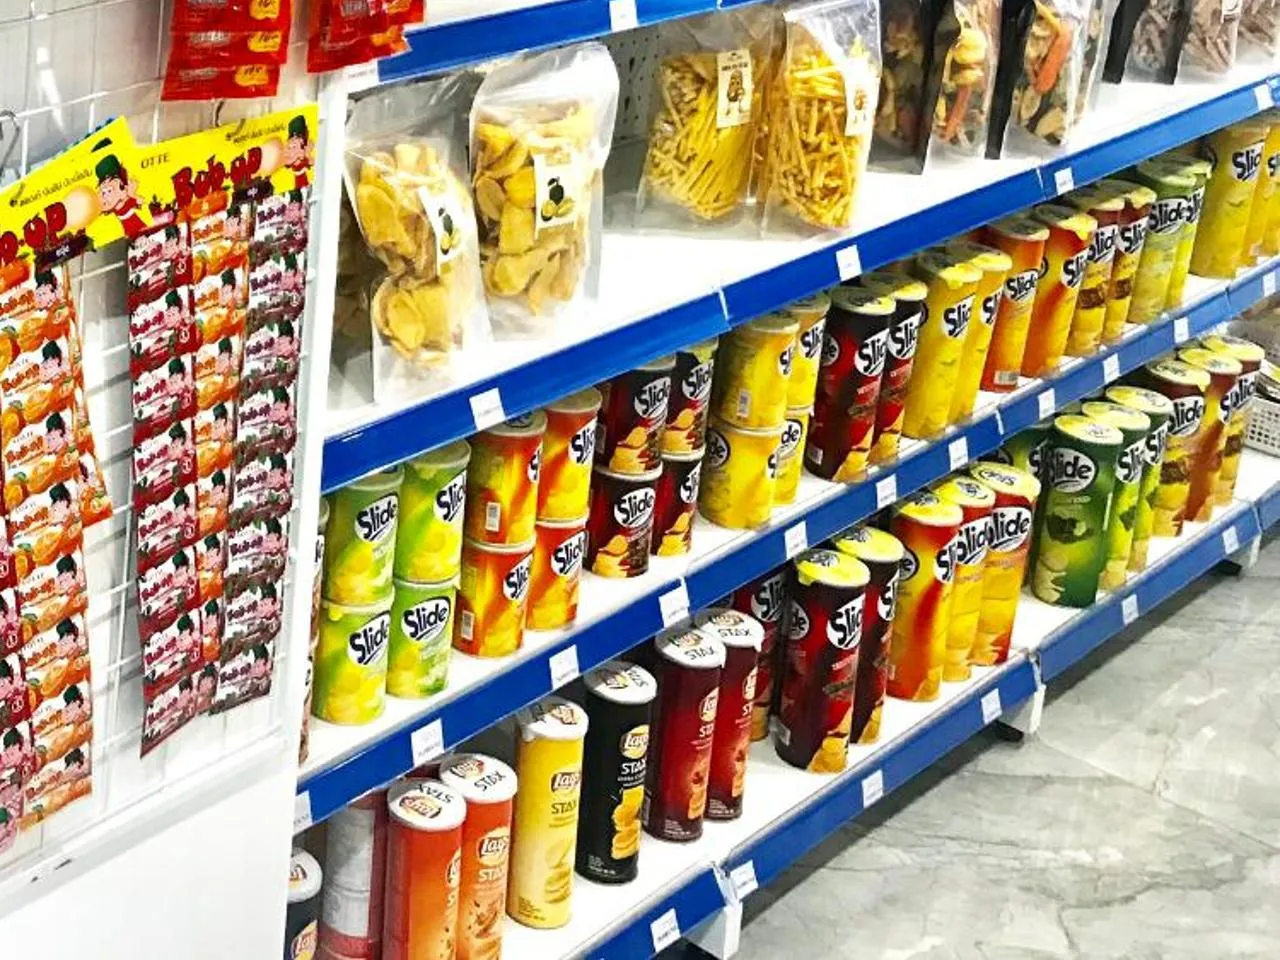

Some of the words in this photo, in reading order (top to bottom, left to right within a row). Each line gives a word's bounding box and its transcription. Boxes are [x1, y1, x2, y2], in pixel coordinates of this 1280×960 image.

[1232, 147, 1261, 181] Sli
[944, 299, 975, 337] Sli
[858, 335, 887, 374] Sli
[891, 319, 919, 357] Sli
[403, 602, 449, 642] Slide
[831, 603, 863, 648] Sli
